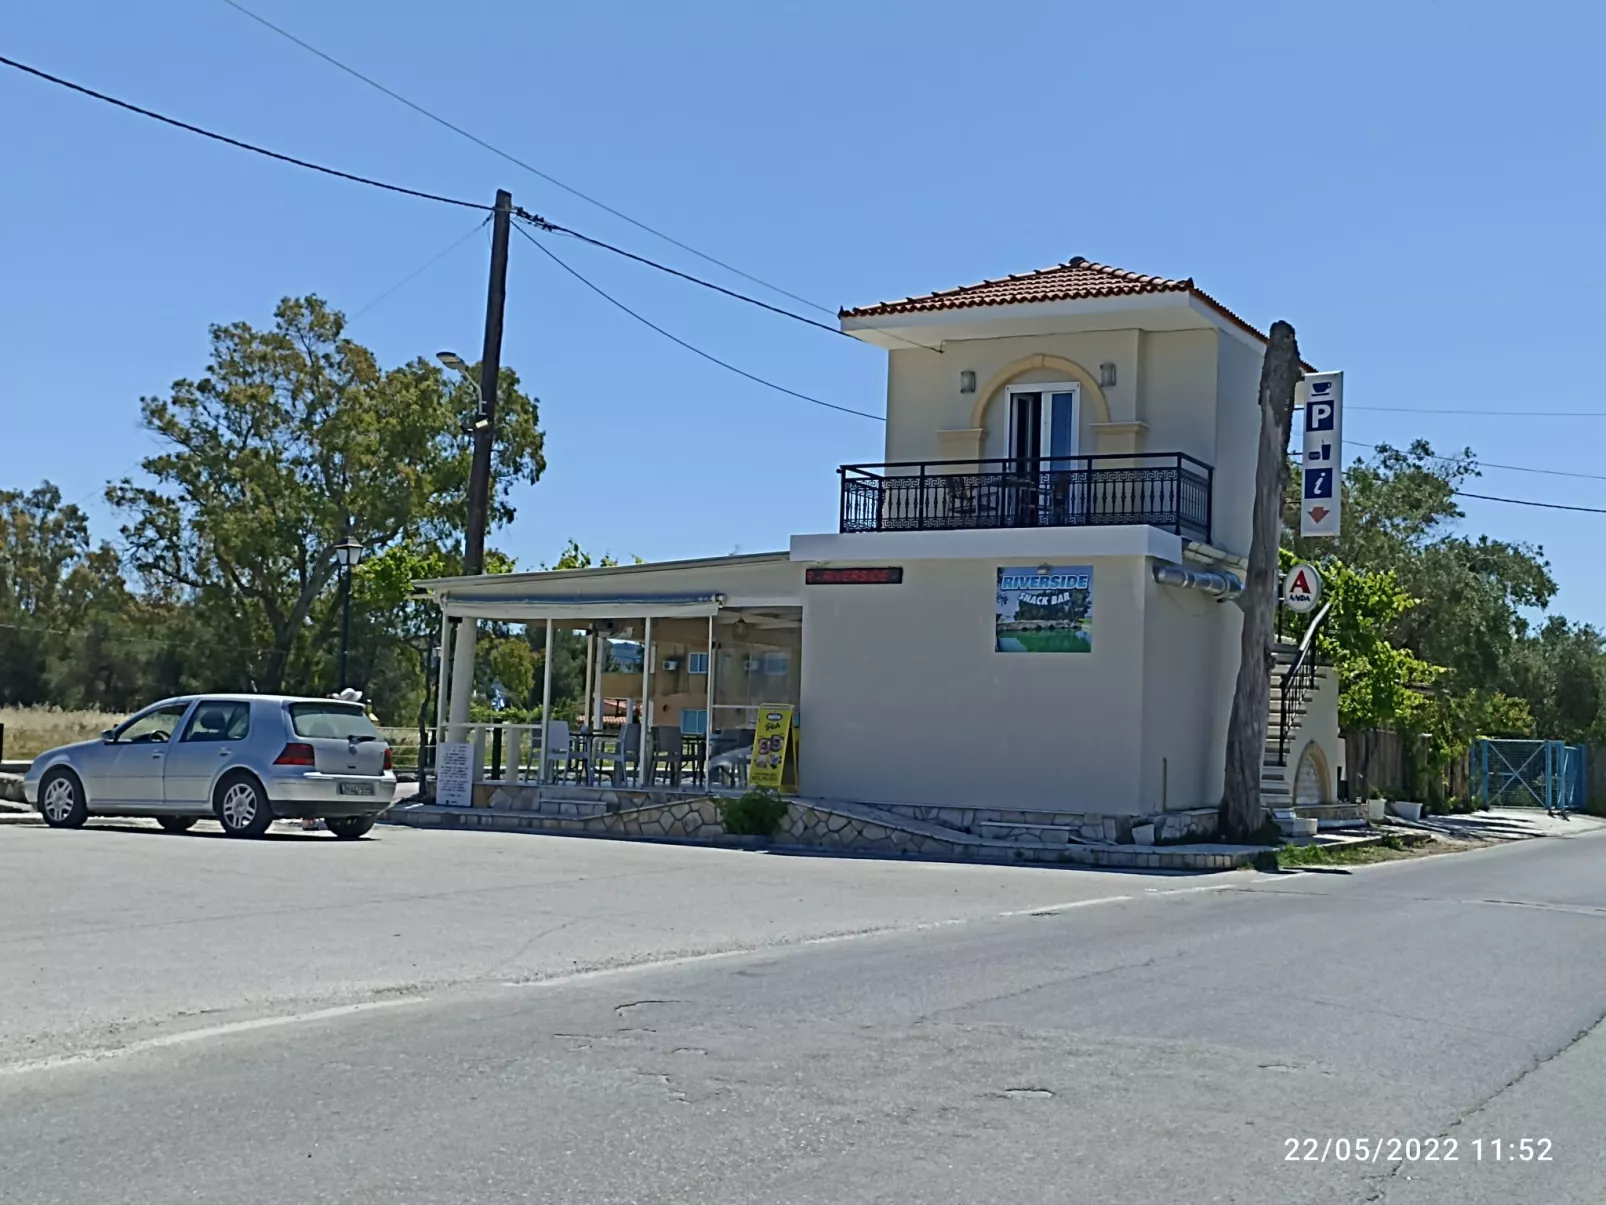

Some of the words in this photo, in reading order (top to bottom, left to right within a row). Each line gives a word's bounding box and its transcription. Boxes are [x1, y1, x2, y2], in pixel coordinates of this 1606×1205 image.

[1311, 404, 1331, 429] P
[1314, 472, 1326, 495] i
[1001, 574, 1089, 590] RIVERSIDE
[1018, 592, 1049, 605] SNACK
[1050, 592, 1071, 605] BAR
